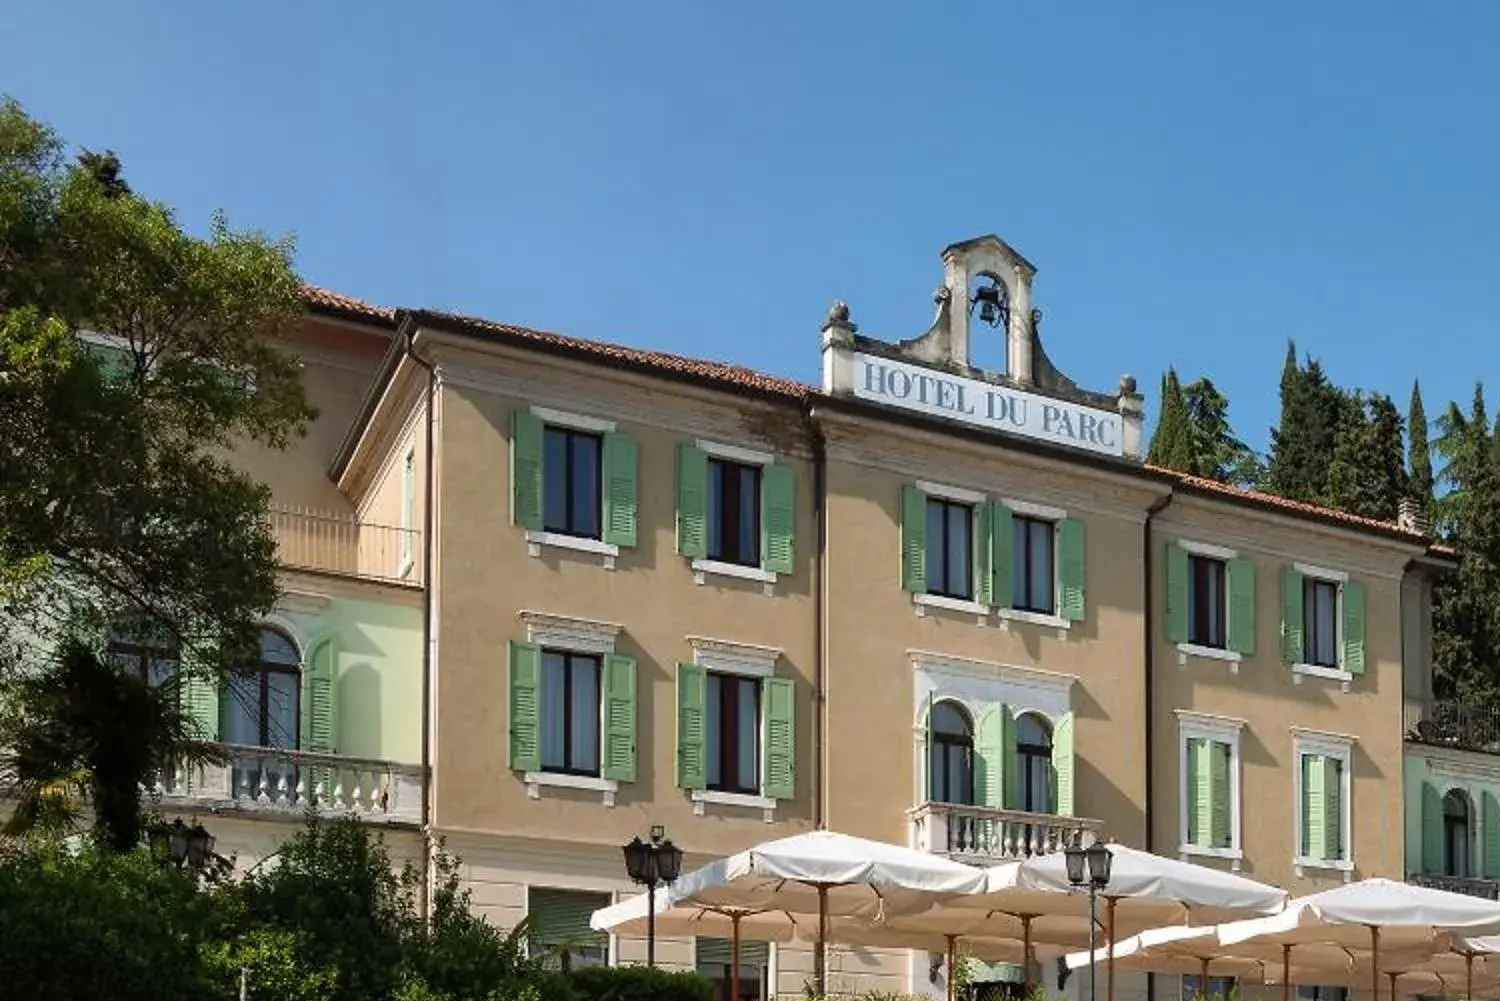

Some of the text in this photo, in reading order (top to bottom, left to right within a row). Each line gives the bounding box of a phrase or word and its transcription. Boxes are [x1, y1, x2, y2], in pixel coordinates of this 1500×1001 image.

[864, 362, 1115, 447] HOTEL DU PARC
